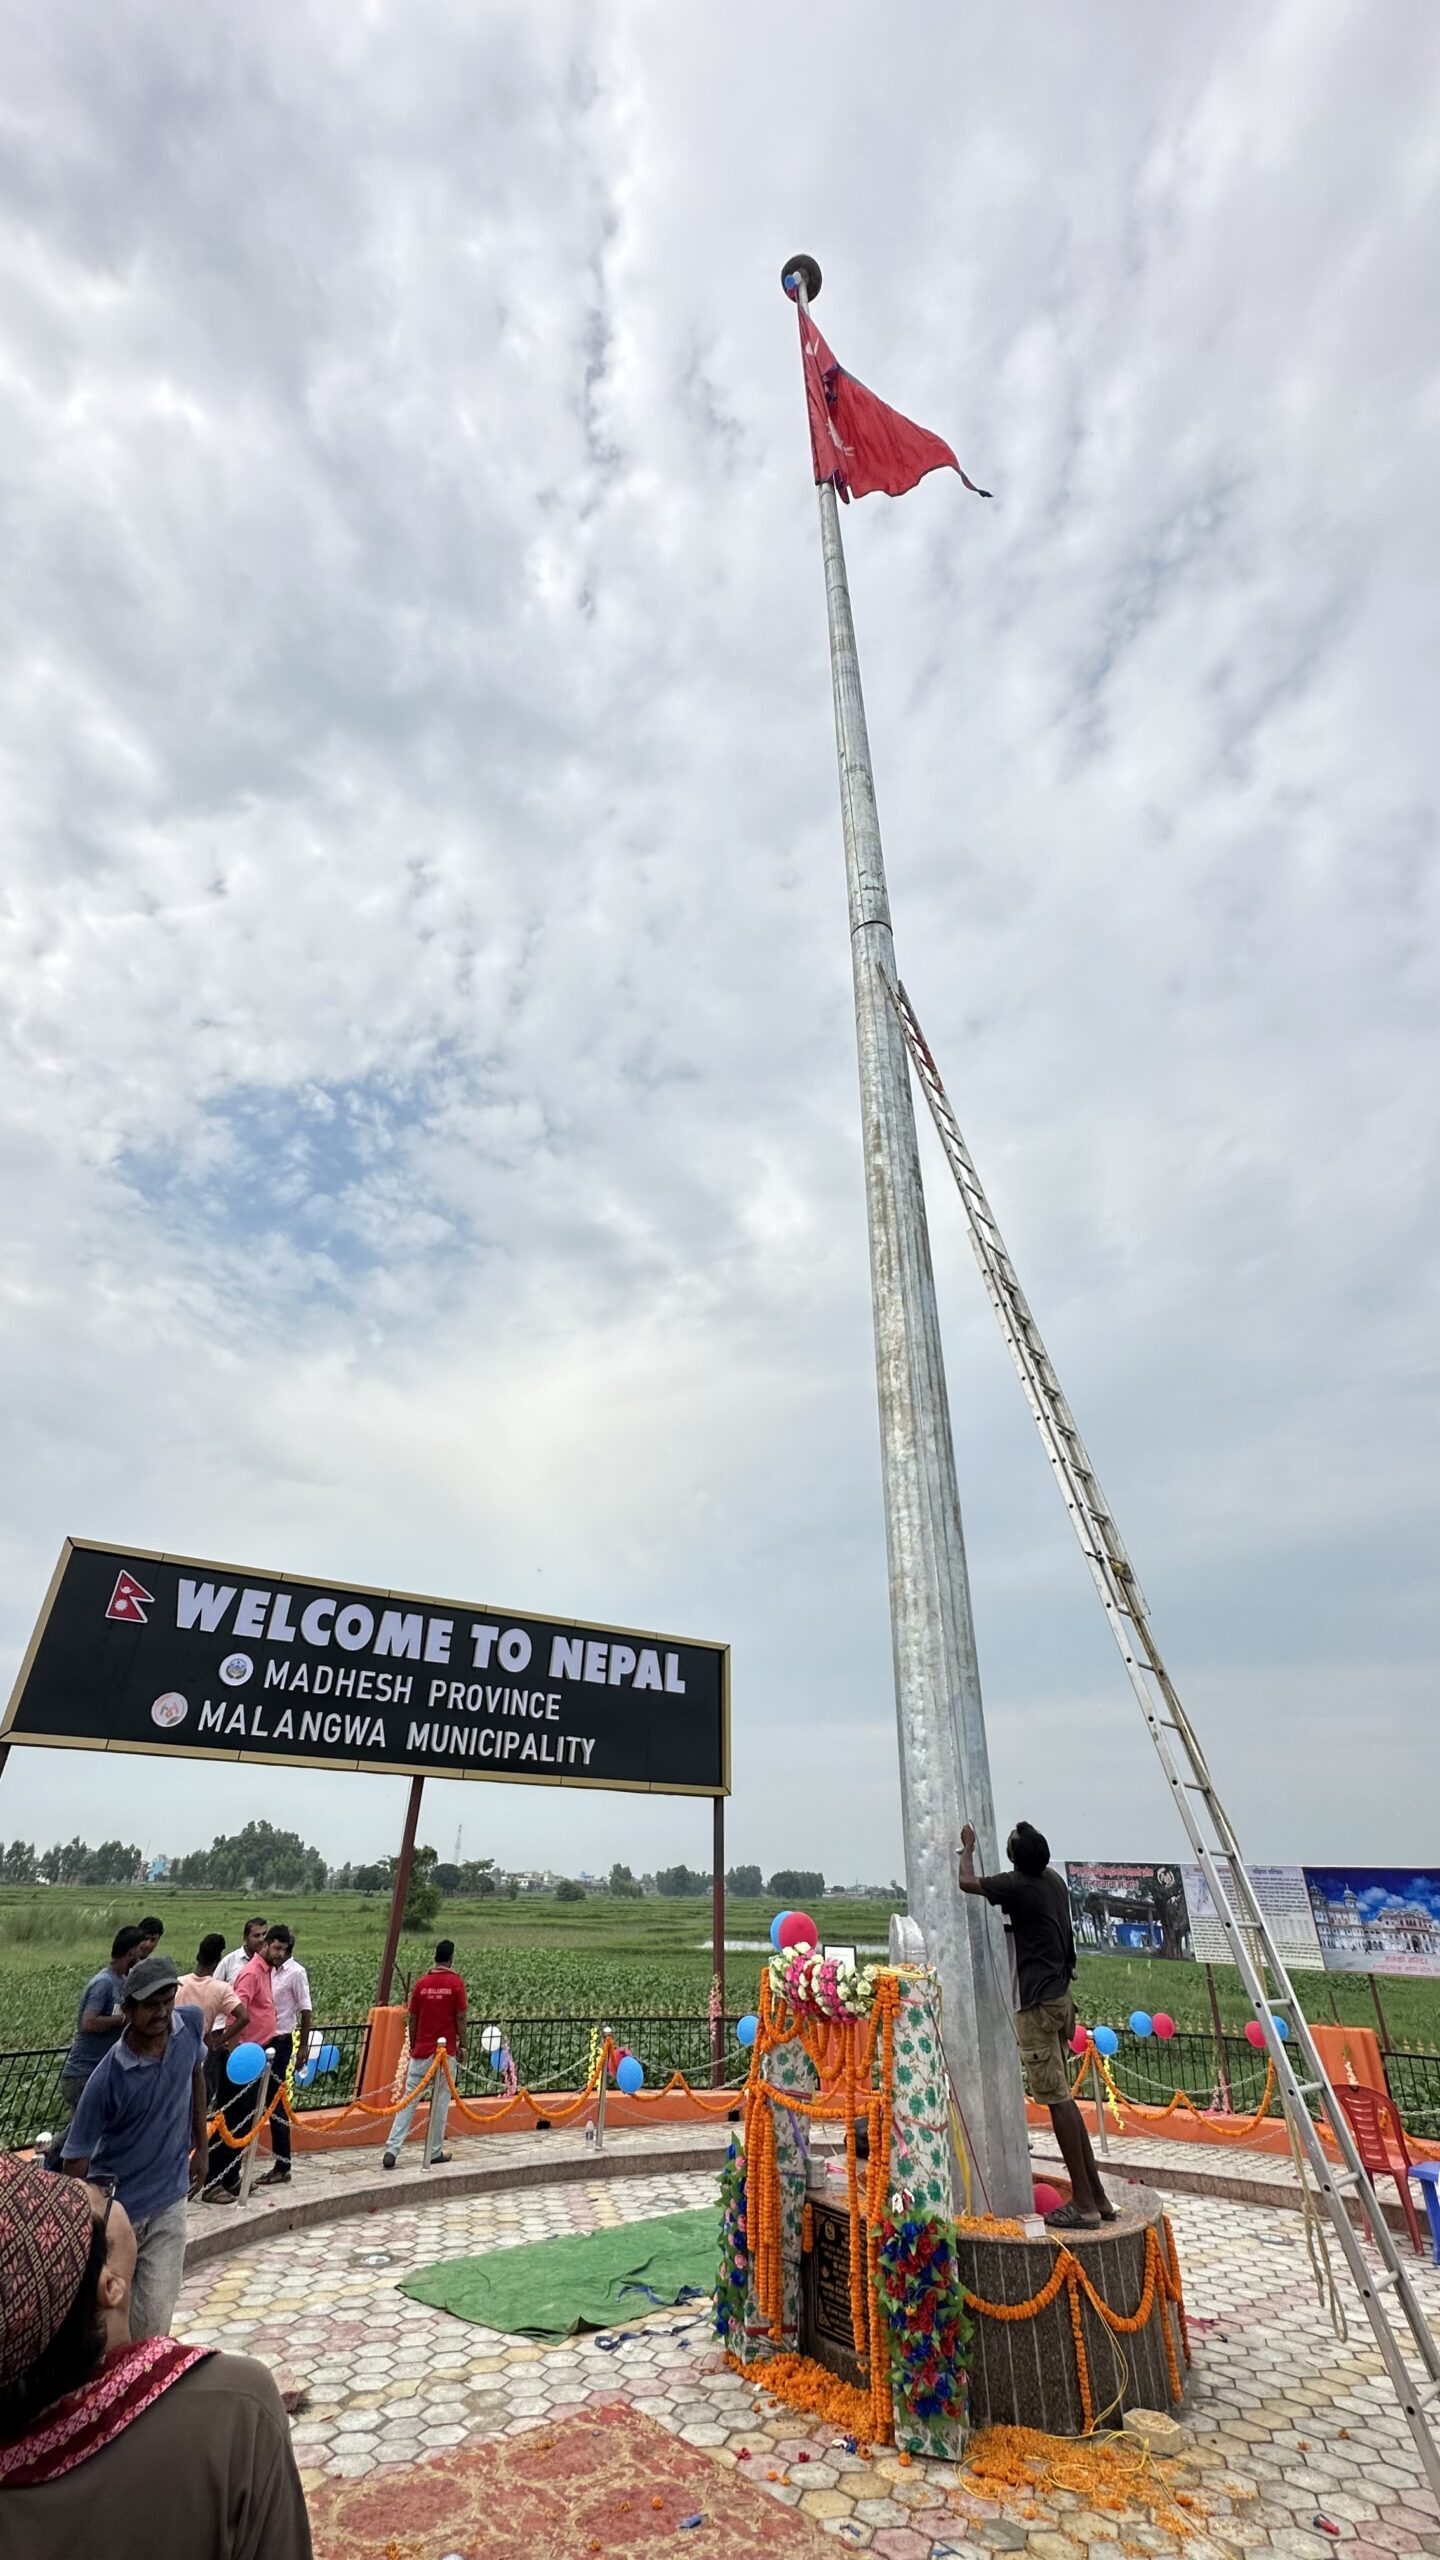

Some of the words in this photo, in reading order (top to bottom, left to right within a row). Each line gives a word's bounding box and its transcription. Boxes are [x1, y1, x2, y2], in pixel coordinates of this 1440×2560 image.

[177, 1579, 453, 1663] WELCOME
[471, 1624, 532, 1672] TO
[549, 1636, 685, 1693] NEPAL
[264, 1660, 413, 1703] MADHESH
[429, 1680, 561, 1720] PROVINCE
[198, 1700, 386, 1747] MALANGWA
[407, 1722, 595, 1764] MUNICIPALITY
